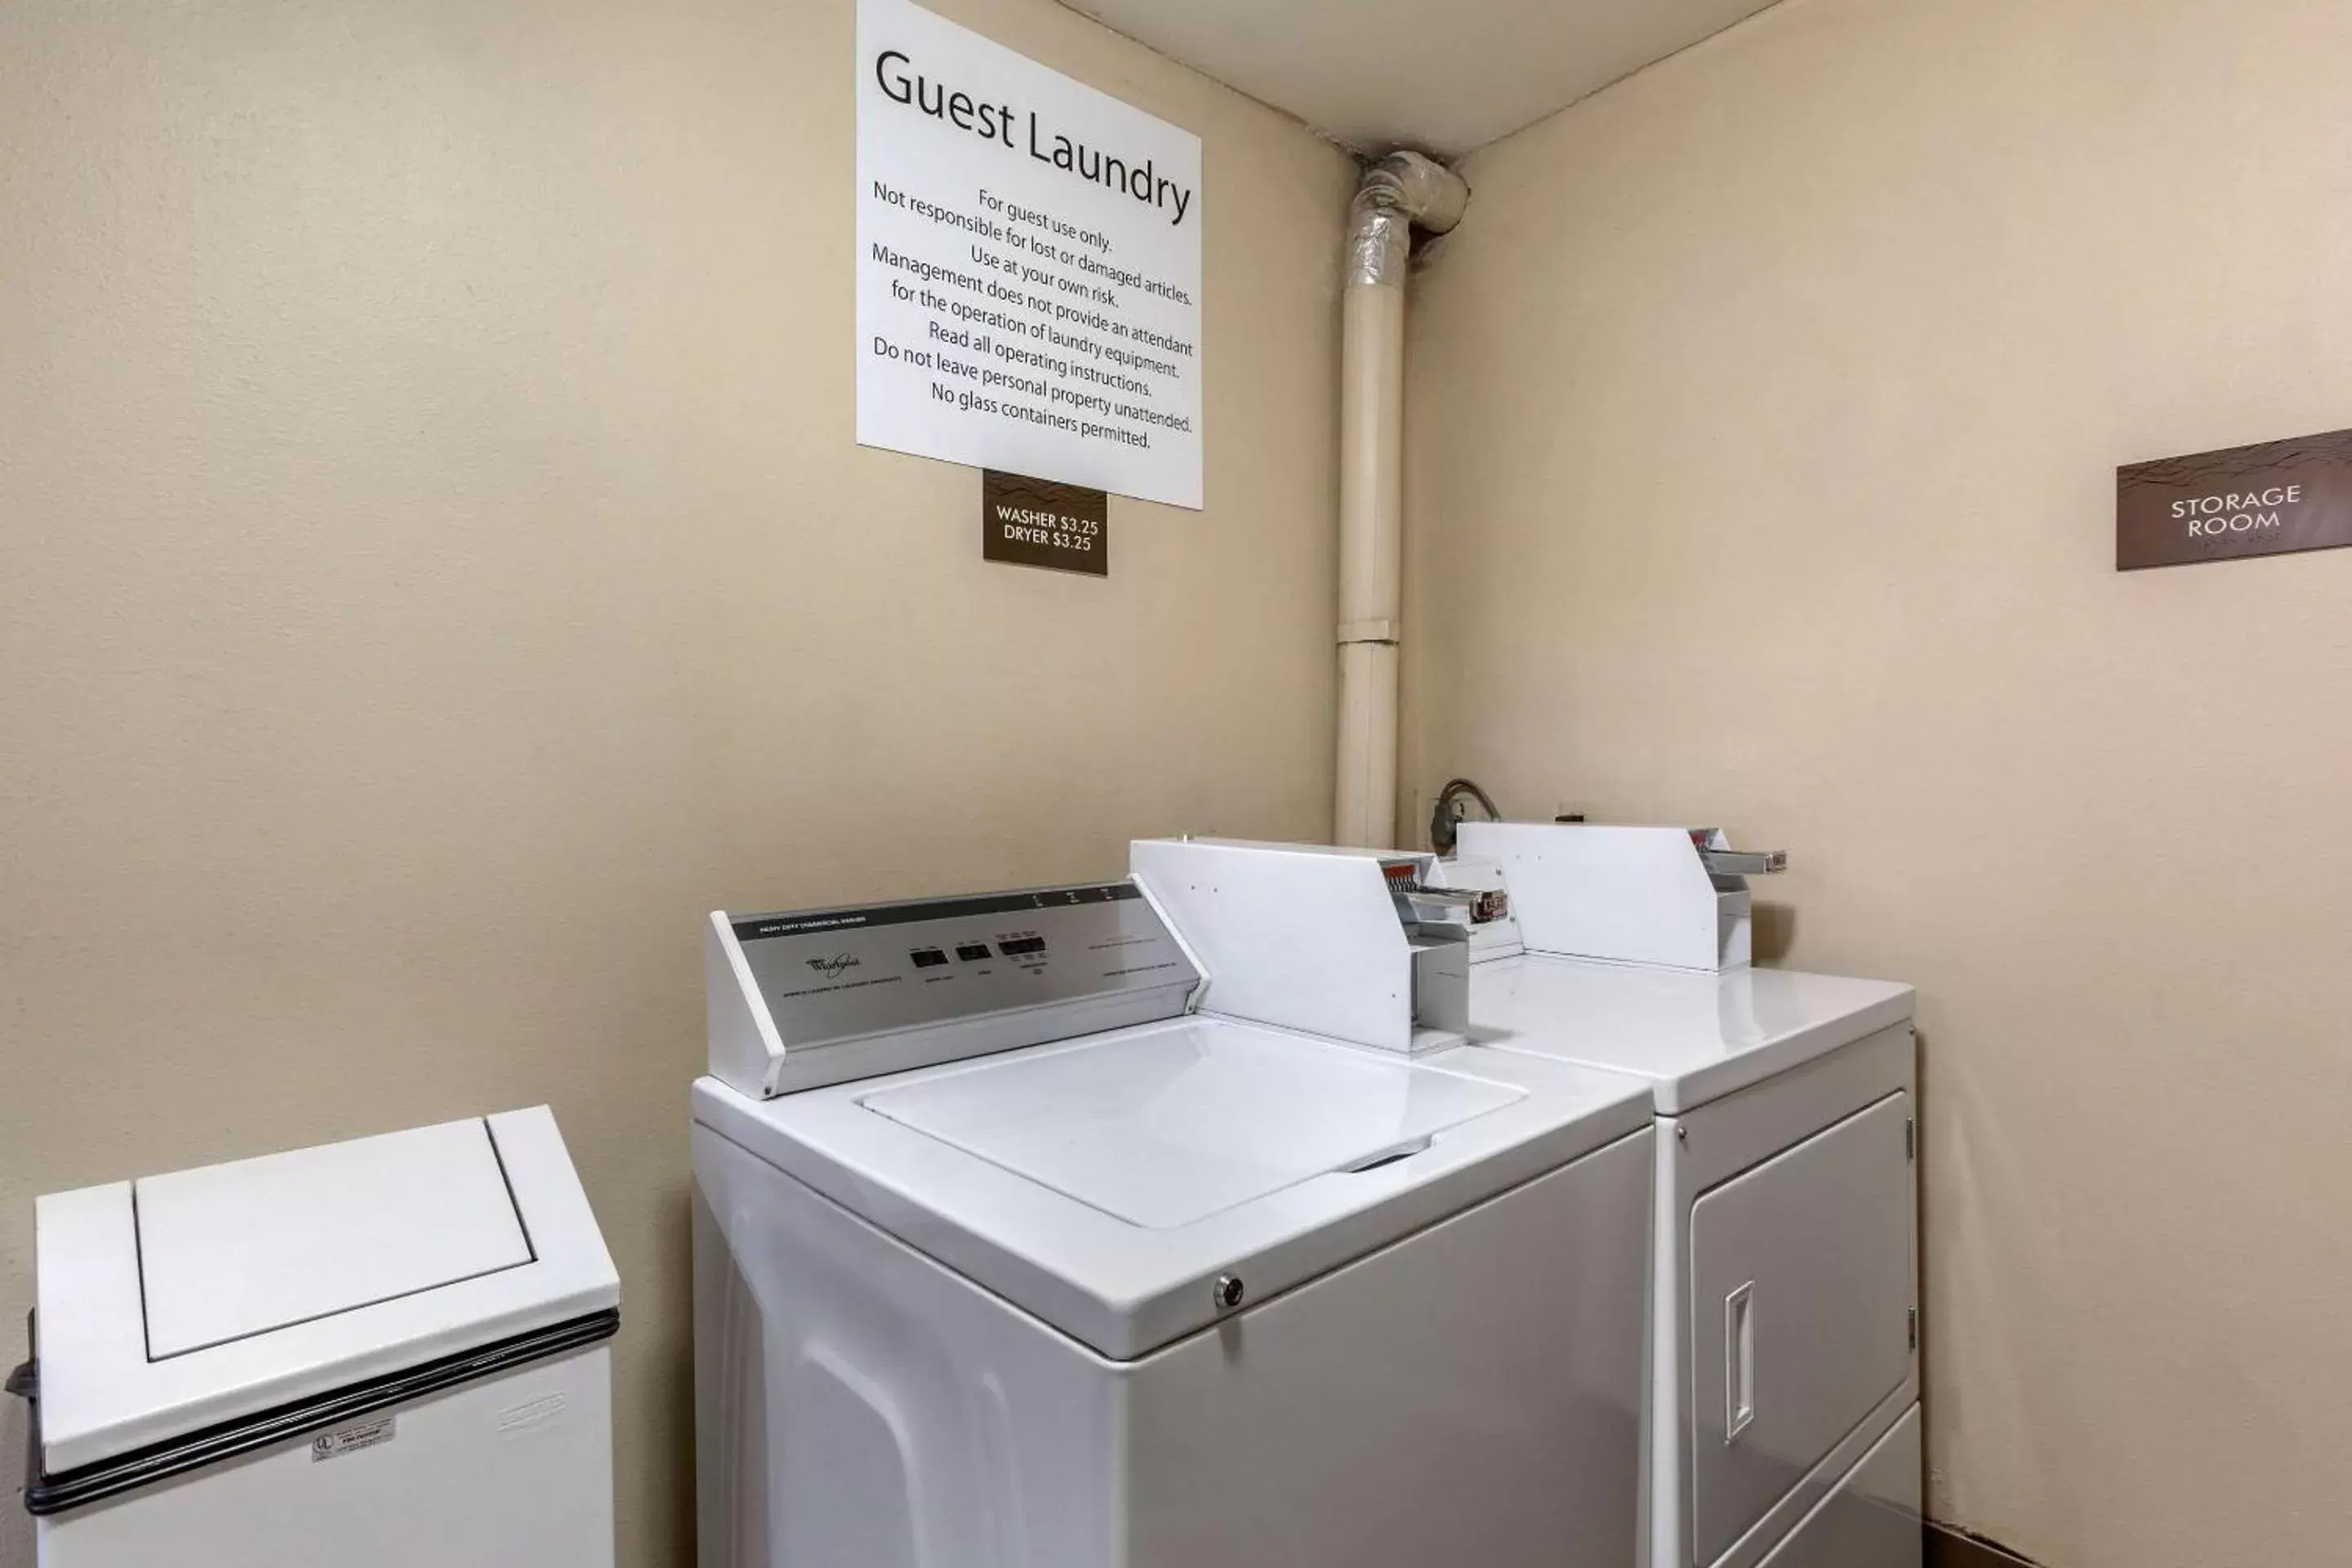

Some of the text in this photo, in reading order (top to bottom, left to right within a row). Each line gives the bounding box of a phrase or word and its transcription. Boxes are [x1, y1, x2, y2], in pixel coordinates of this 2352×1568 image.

[876, 50, 1192, 226] Guest Laundry
[875, 180, 1192, 305] Not responsible for lost or damaged articles.
[979, 189, 1112, 254] For guest use only.
[873, 243, 1194, 358] Management does not provide an attendant
[972, 245, 1119, 309] Use at your own risk.
[892, 279, 1179, 381] for the operation of laundry equipment.
[929, 320, 1152, 398] Read all operating instructions.
[875, 336, 1192, 433] Do not leave personal property unattended.
[933, 382, 1151, 451] No glass containers permitted.
[996, 505, 1098, 535] WASHER $3.25
[2172, 484, 2302, 519] STORAGE
[2188, 511, 2281, 537] ROOM
[1004, 524, 1091, 551] DRYER $3.25
